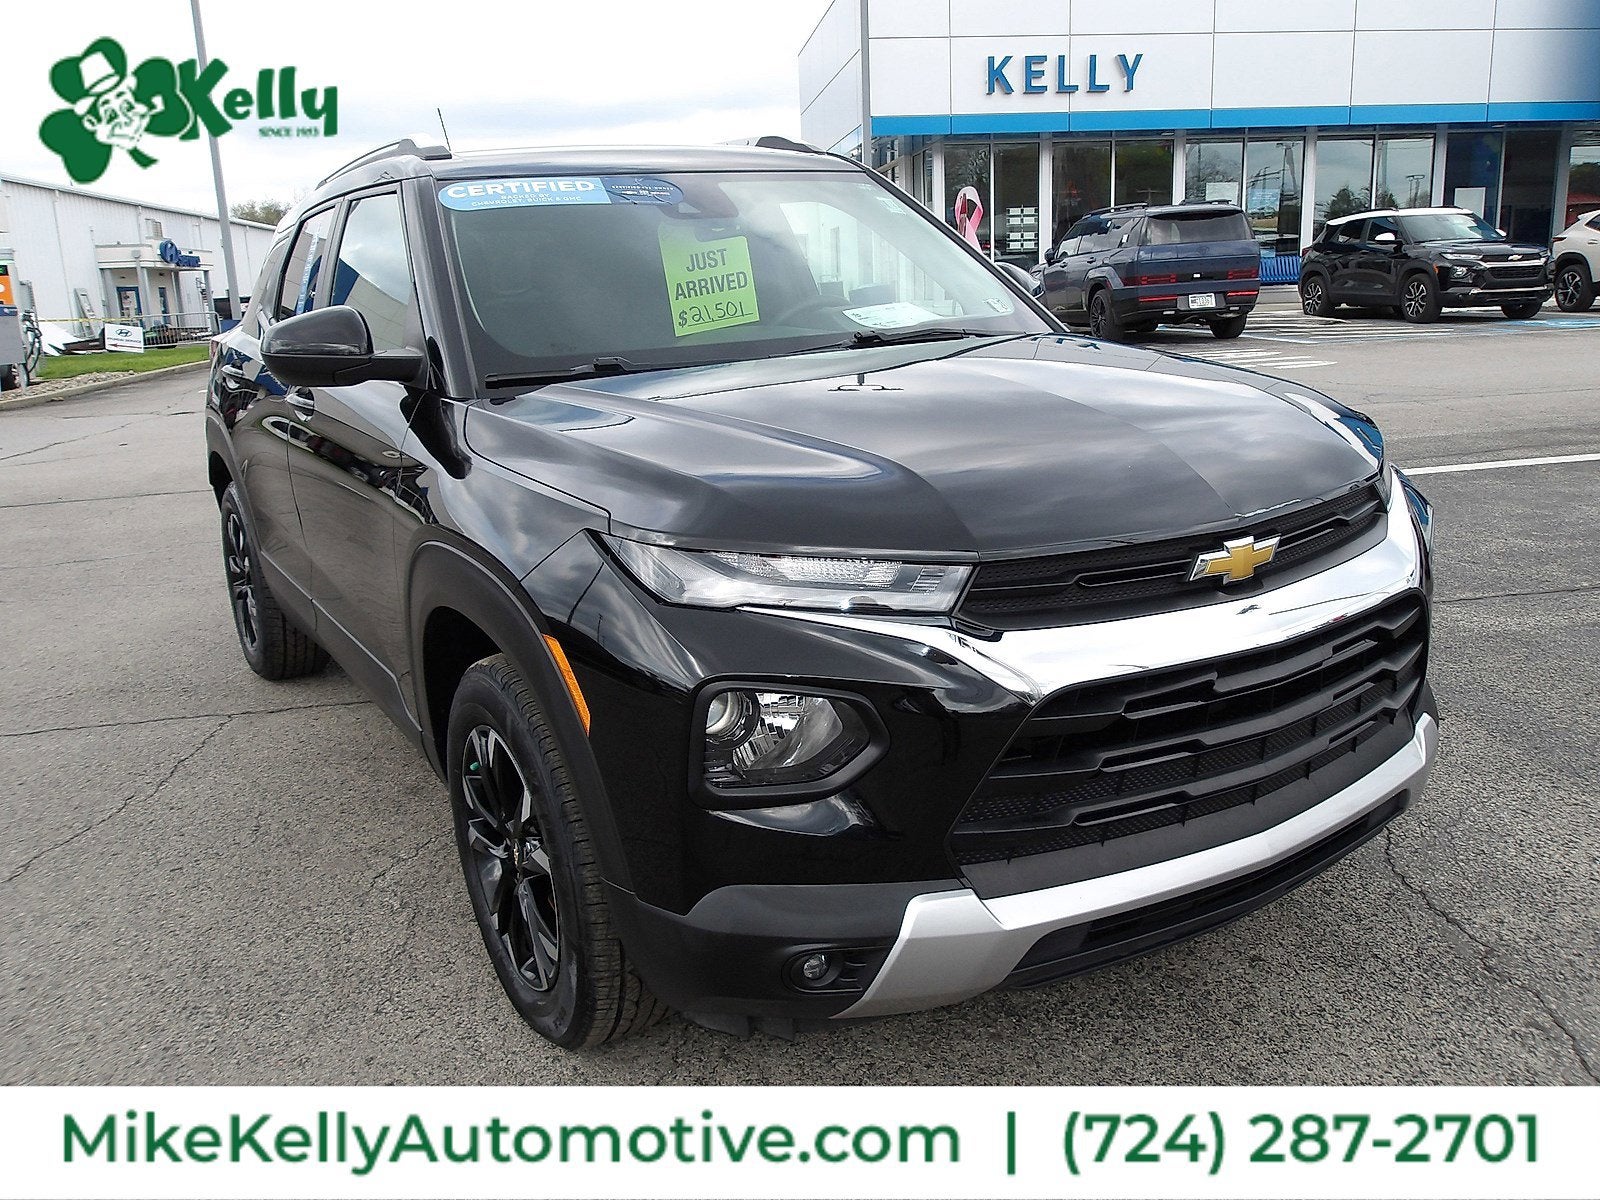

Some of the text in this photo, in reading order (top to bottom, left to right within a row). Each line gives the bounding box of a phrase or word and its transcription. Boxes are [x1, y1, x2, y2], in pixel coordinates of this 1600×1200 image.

[986, 54, 1143, 95] KELLY
[447, 180, 596, 199] CERTIFIED
[685, 248, 727, 273] JUST
[675, 271, 748, 301] ARRIVED
[678, 301, 745, 328] $21,501
